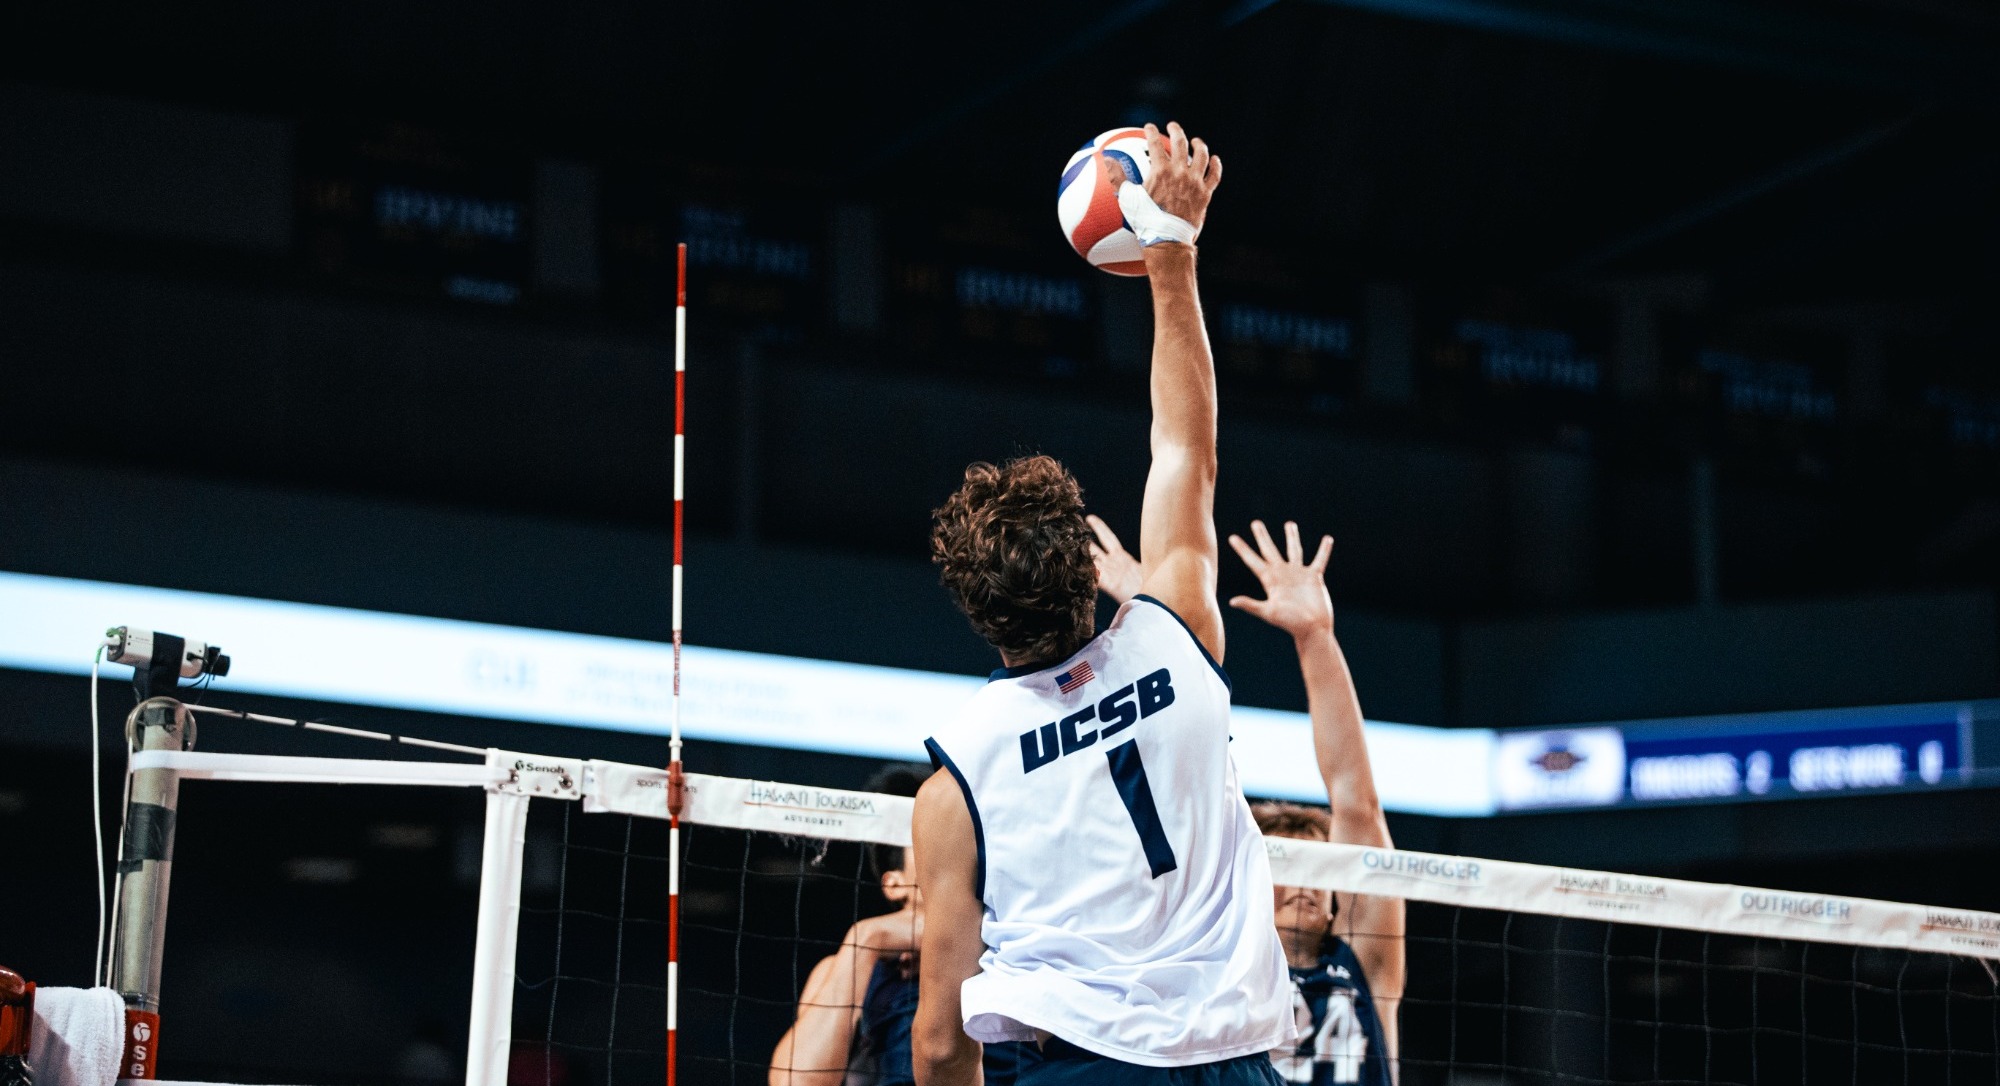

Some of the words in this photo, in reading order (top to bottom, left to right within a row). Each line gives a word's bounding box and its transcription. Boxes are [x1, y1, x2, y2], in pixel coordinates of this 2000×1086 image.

[1019, 667, 1176, 775] UCSB
[526, 762, 565, 775] Senoh
[1105, 738, 1178, 880] 1
[1363, 851, 1481, 880] OUTRIGGER
[1740, 891, 1851, 919] OUTRIGGER
